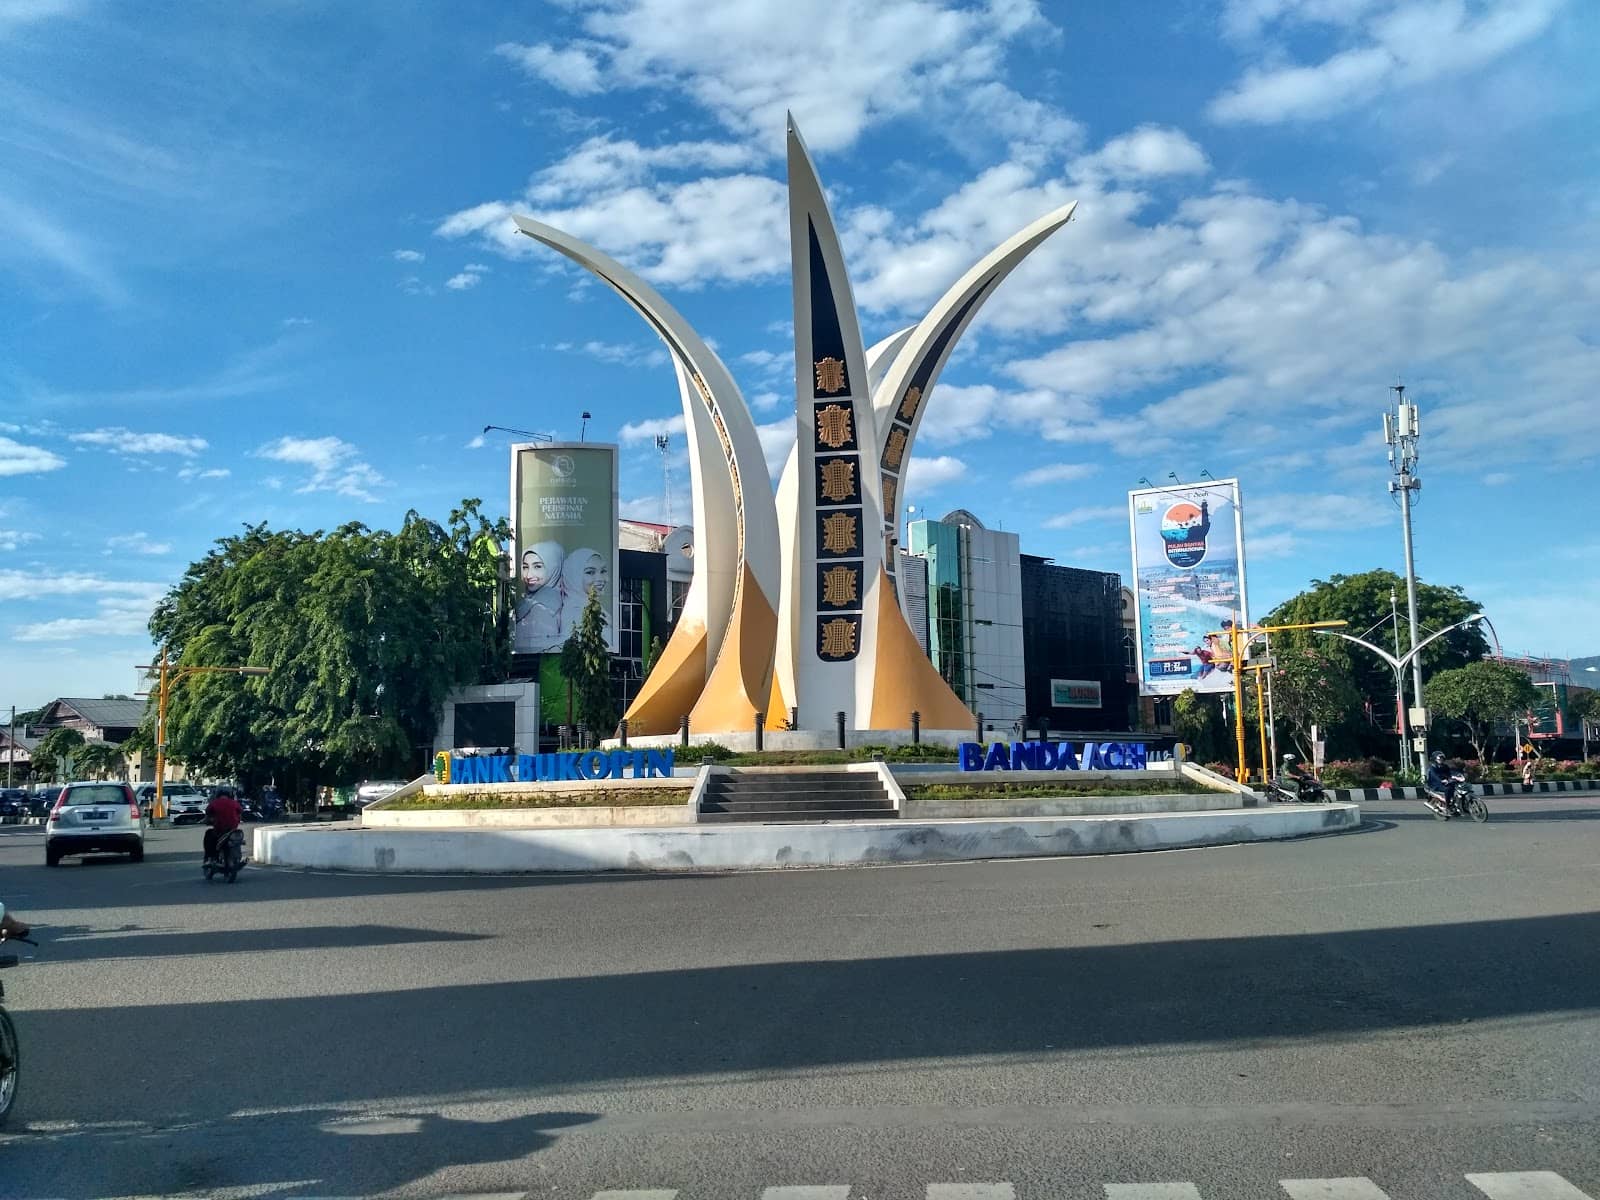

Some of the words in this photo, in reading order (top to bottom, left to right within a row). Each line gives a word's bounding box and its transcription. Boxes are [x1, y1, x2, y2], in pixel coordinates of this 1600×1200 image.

[545, 512, 583, 520] NATASHA
[451, 756, 514, 784] BANK
[518, 748, 675, 782] BUKOPIN
[958, 742, 1080, 770] BANDA
[1080, 742, 1147, 770] ACEH
